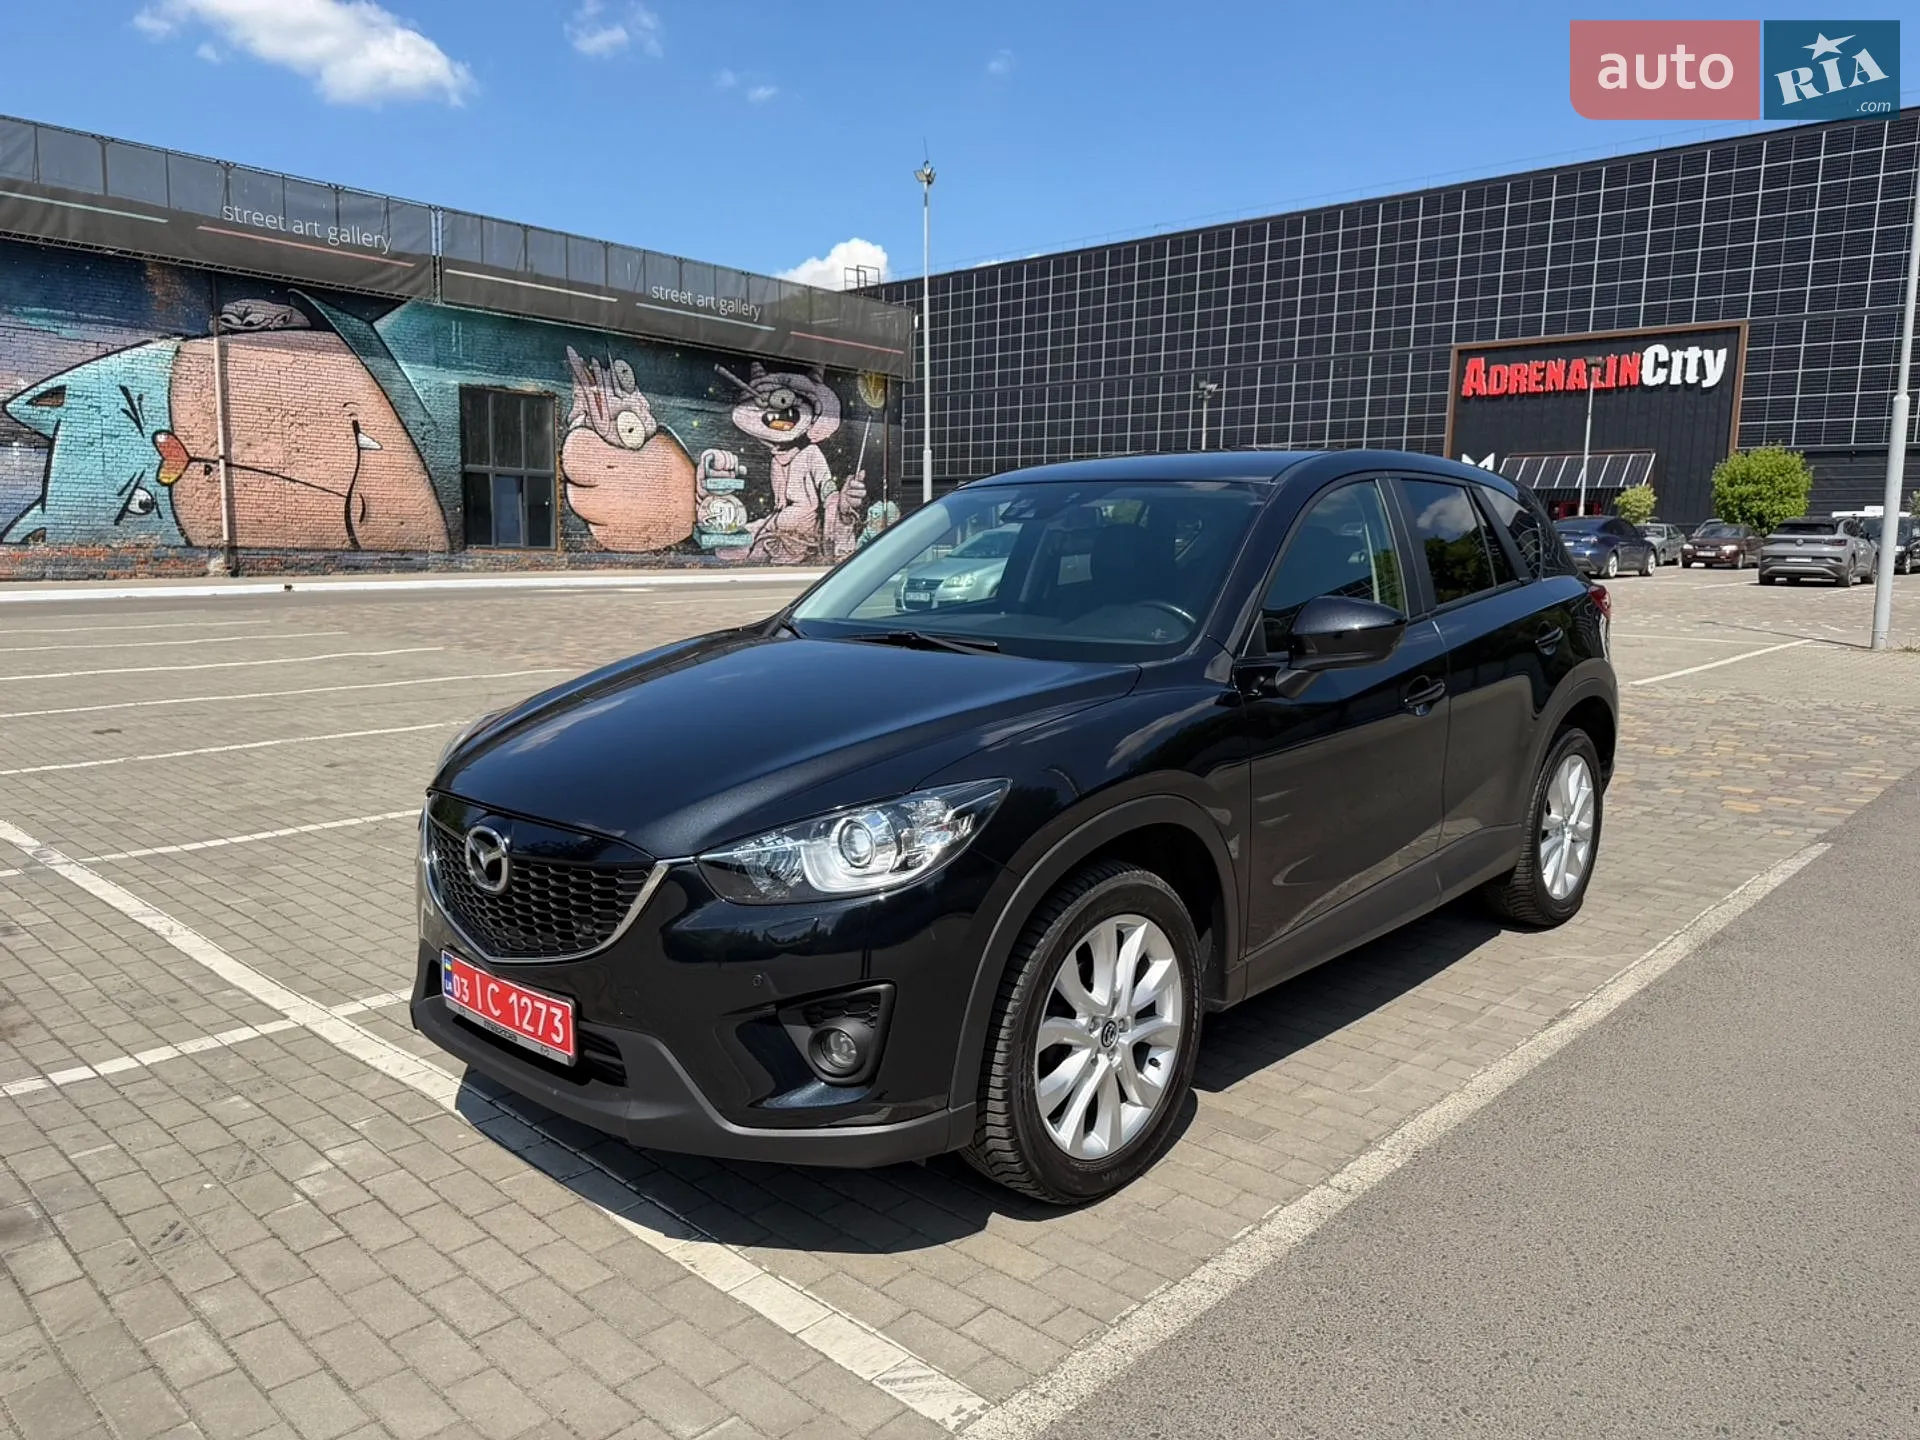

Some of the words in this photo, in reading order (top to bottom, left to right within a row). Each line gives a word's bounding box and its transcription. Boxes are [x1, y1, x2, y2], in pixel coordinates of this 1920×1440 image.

[222, 204, 287, 232] street
[292, 218, 321, 239] art
[327, 225, 392, 255] gallery
[651, 285, 693, 306] street
[696, 294, 716, 311] art
[719, 298, 761, 323] gallery
[452, 973, 470, 1003] 03
[508, 991, 565, 1044] 1273
